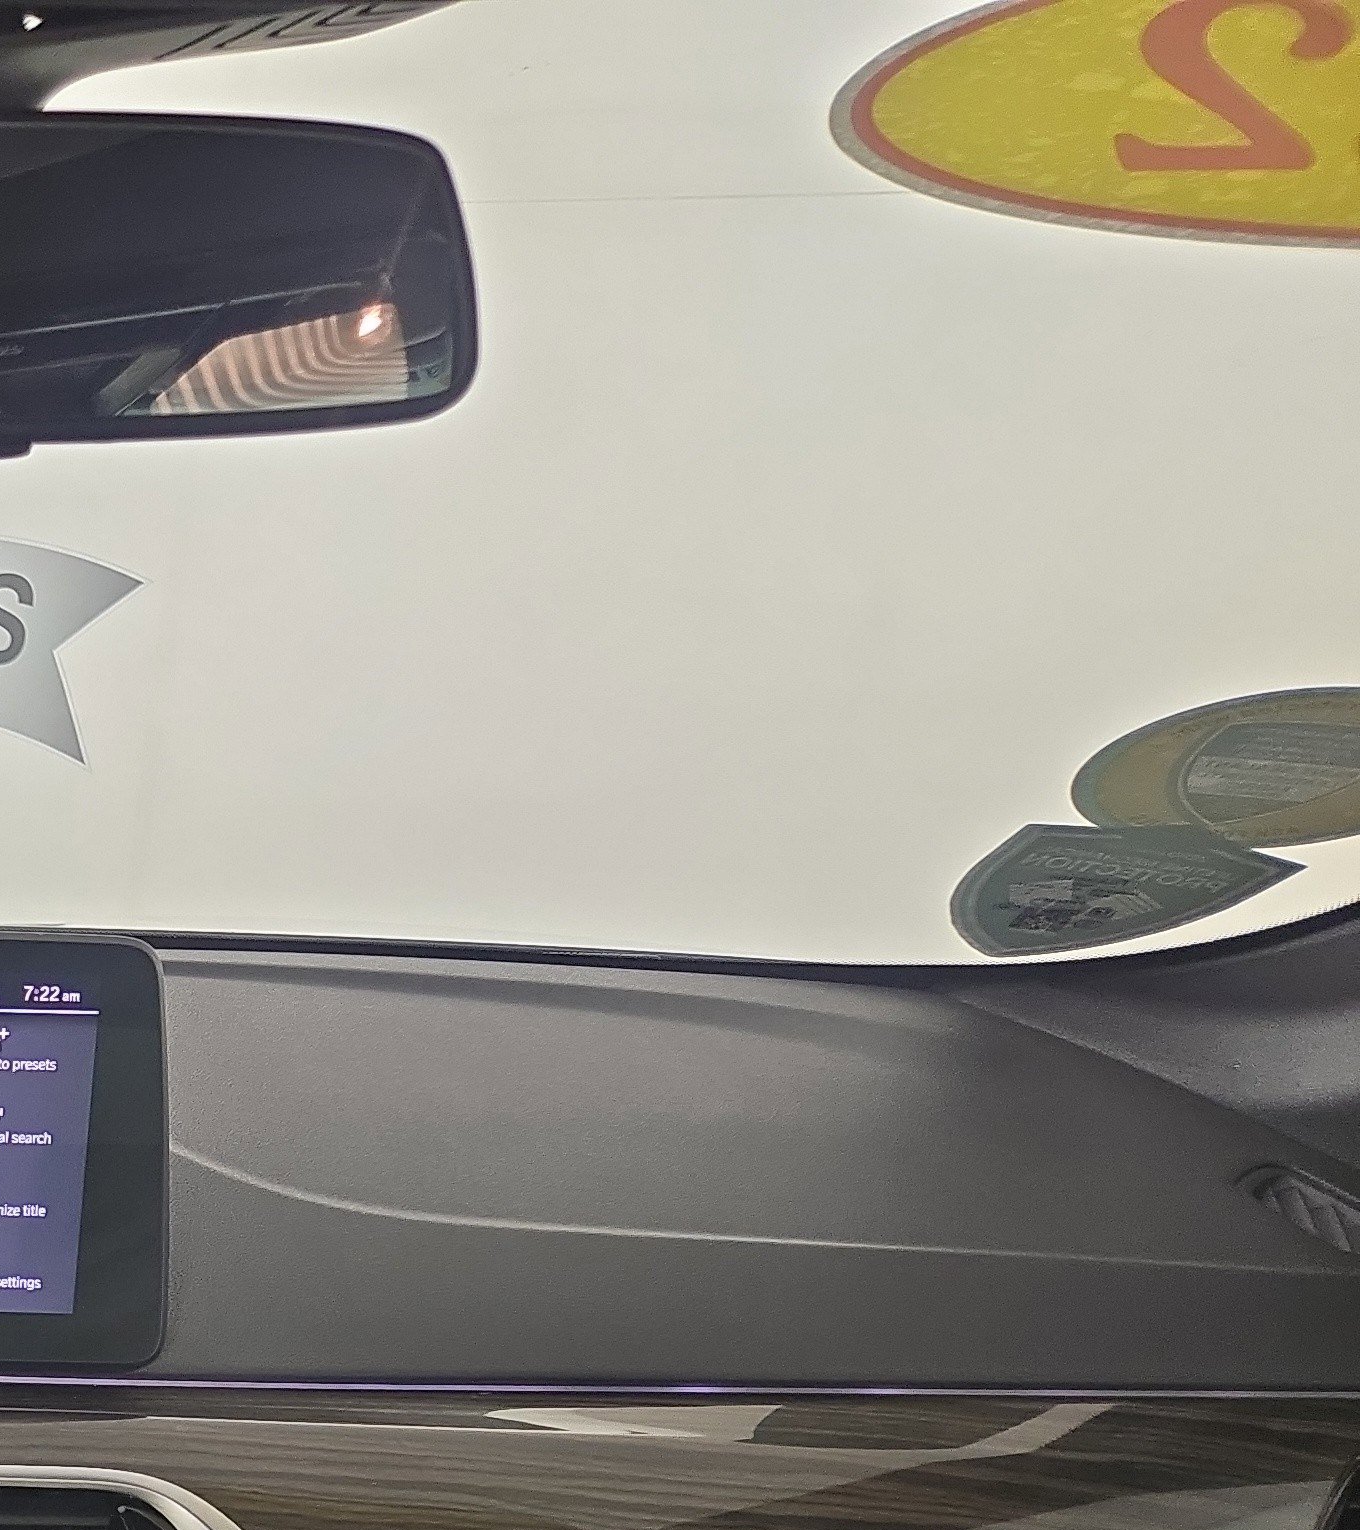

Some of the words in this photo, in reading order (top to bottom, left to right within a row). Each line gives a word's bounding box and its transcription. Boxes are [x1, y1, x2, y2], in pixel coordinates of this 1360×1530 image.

[23, 984, 60, 1002] 7:22
[62, 990, 81, 1003] am
[12, 1058, 57, 1074] presets
[11, 1131, 52, 1145] search
[22, 1204, 47, 1217] title
